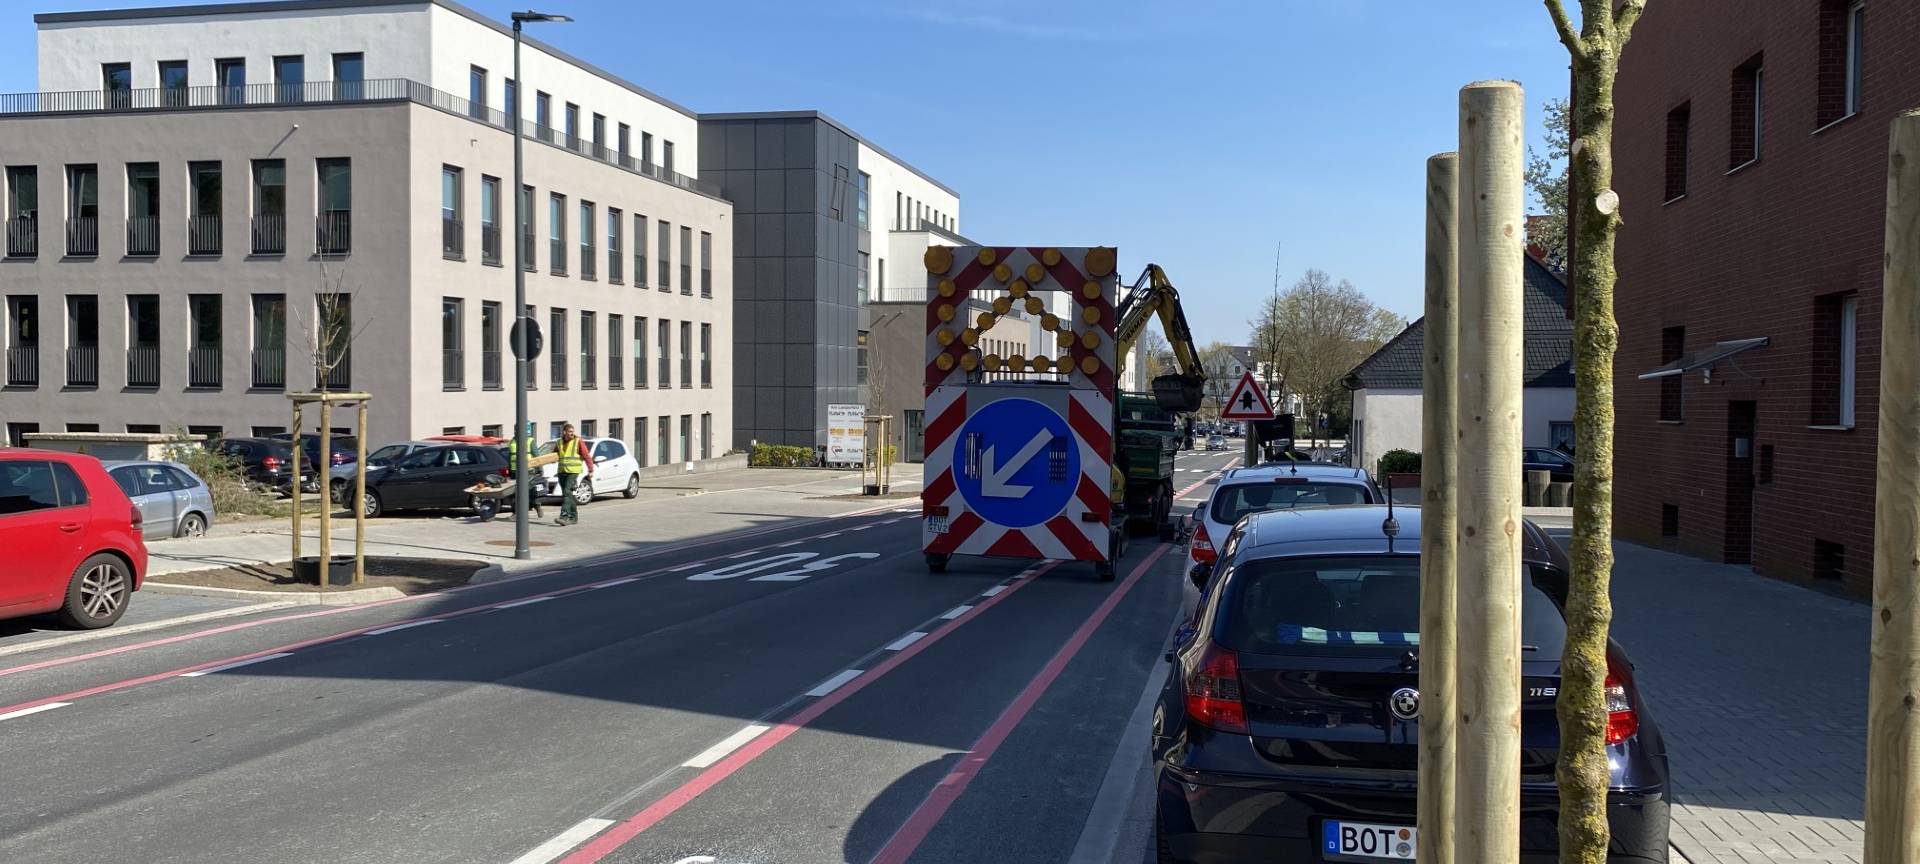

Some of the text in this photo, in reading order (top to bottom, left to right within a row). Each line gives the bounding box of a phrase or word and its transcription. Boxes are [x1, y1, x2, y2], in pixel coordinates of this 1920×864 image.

[686, 552, 880, 581] 30
[1529, 687, 1557, 697] 118
[1341, 826, 1395, 855] BOT
